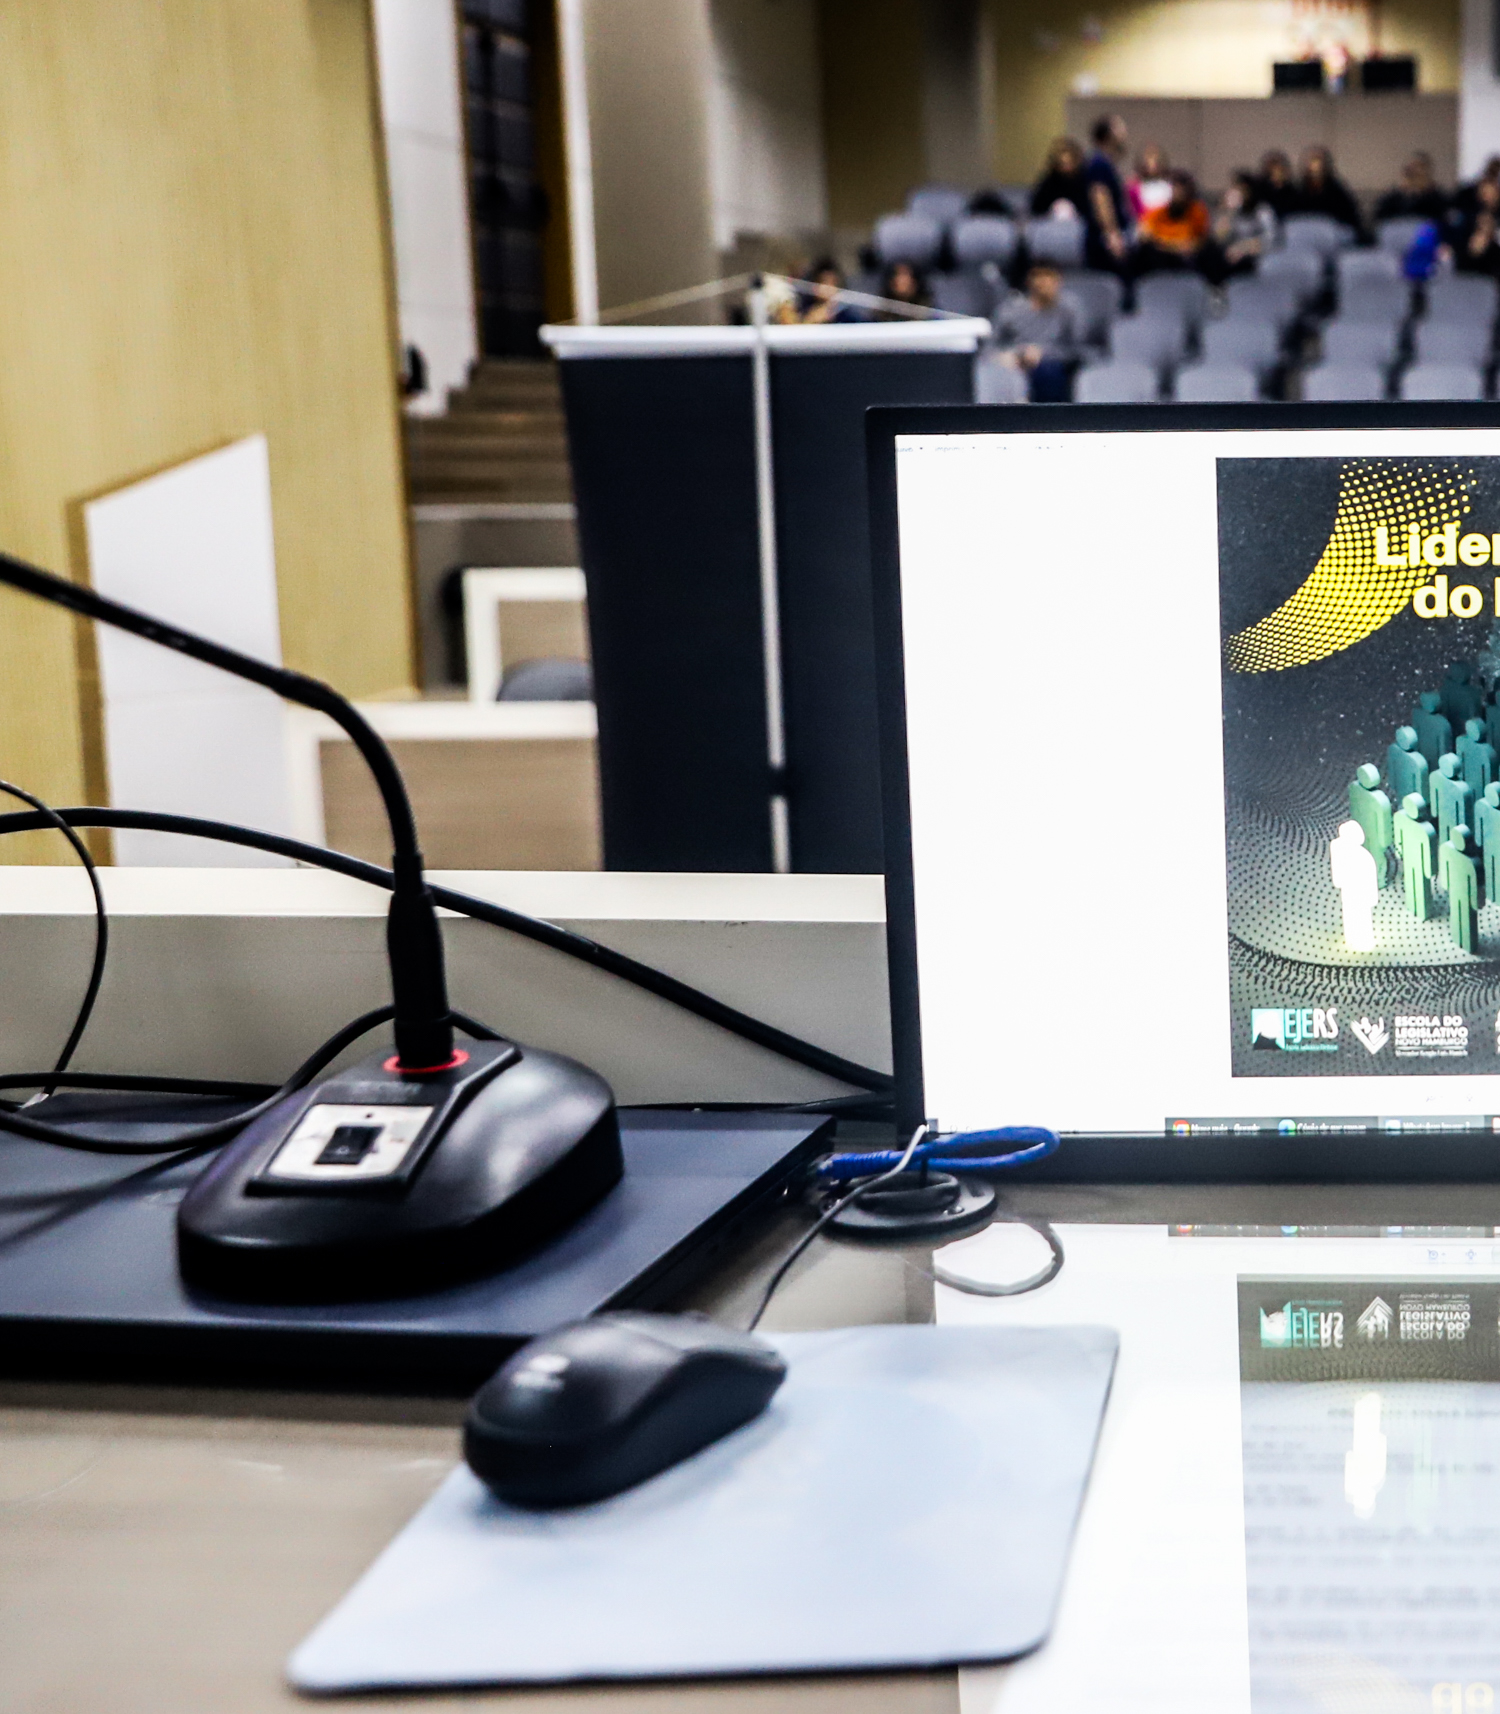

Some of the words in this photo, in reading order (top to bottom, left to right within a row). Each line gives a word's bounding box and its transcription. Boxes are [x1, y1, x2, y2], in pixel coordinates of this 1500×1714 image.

[1412, 574, 1484, 619] do
[1285, 1007, 1339, 1042] EJERS
[1395, 1015, 1441, 1027] ESCOLA
[1443, 1015, 1463, 1027] DO
[1395, 1027, 1469, 1038] LEGISLATIVO
